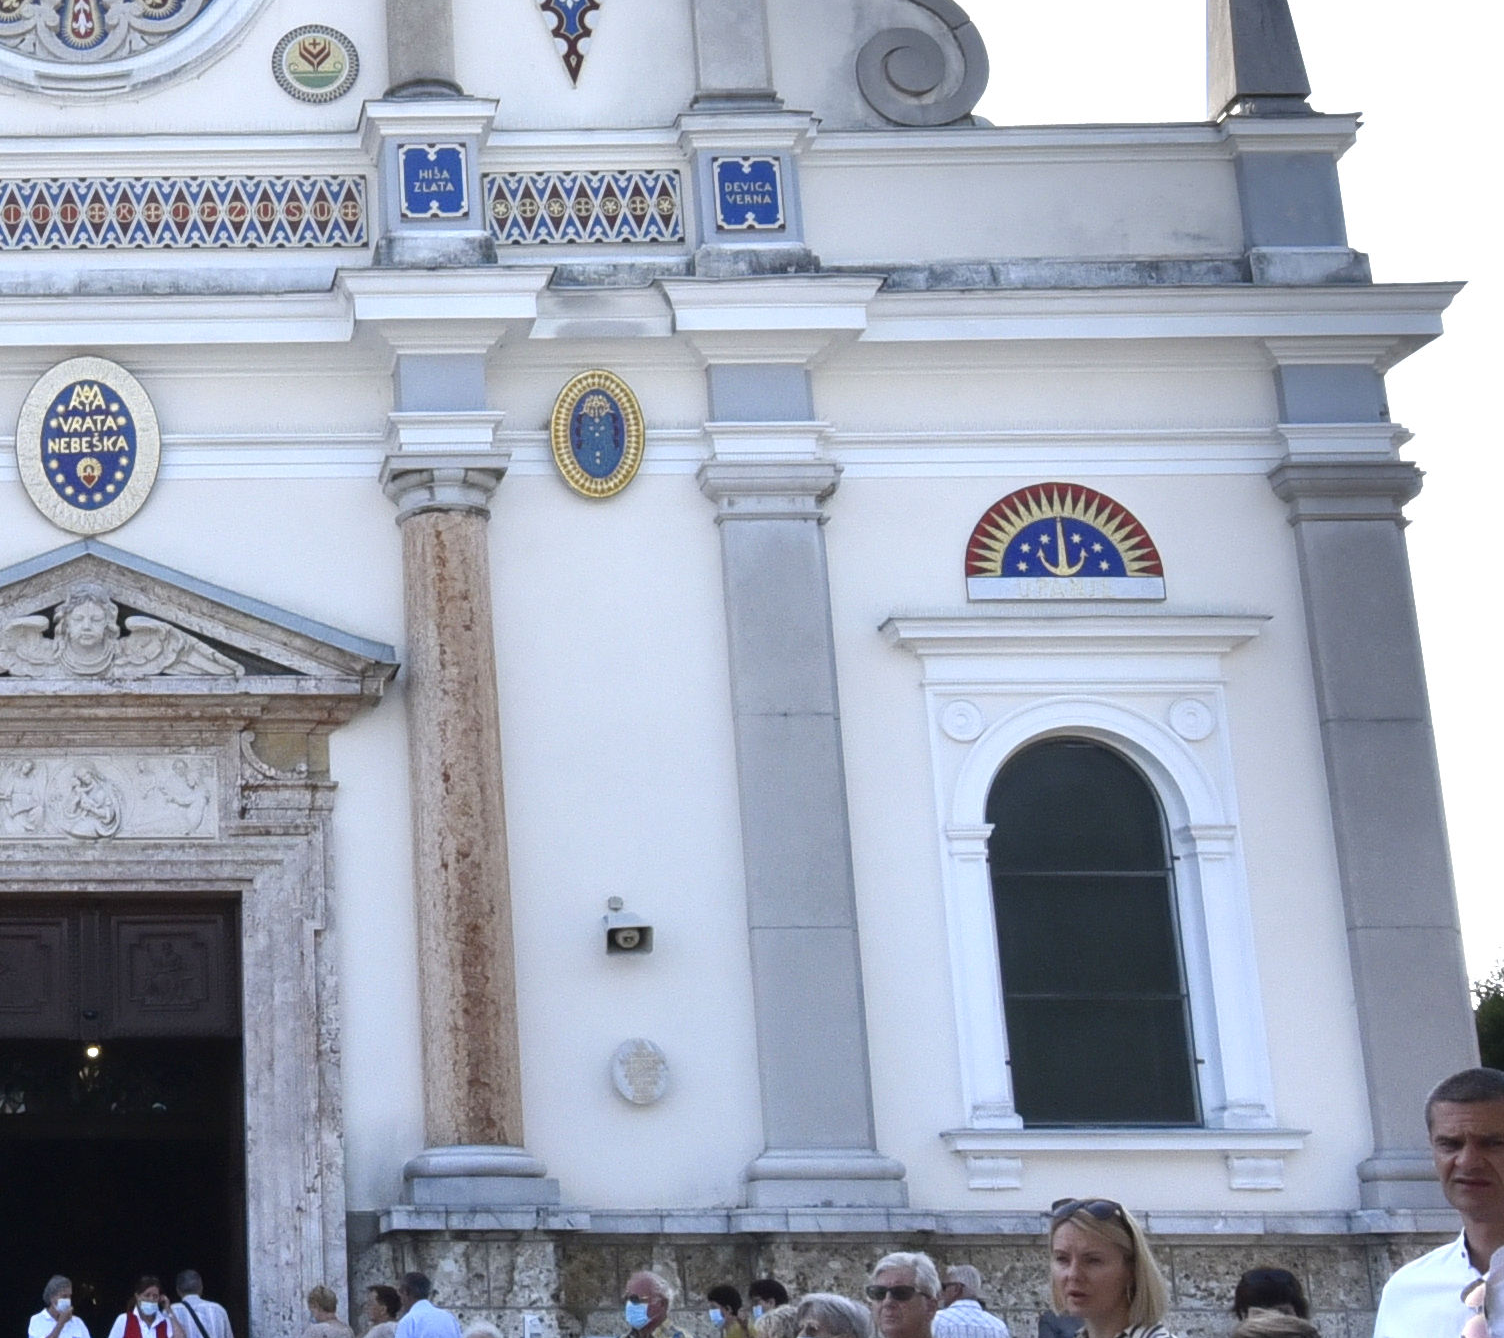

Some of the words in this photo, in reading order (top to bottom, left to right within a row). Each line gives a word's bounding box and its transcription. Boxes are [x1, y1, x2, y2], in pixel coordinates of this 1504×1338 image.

[418, 166, 450, 180] HIŠA
[413, 181, 455, 193] ZLATA
[724, 181, 773, 193] DEVICA
[725, 193, 772, 205] VERNA
[176, 202, 330, 222] JEZUSU
[58, 415, 118, 433] VRATA
[47, 433, 130, 454] NEBEŠKA
